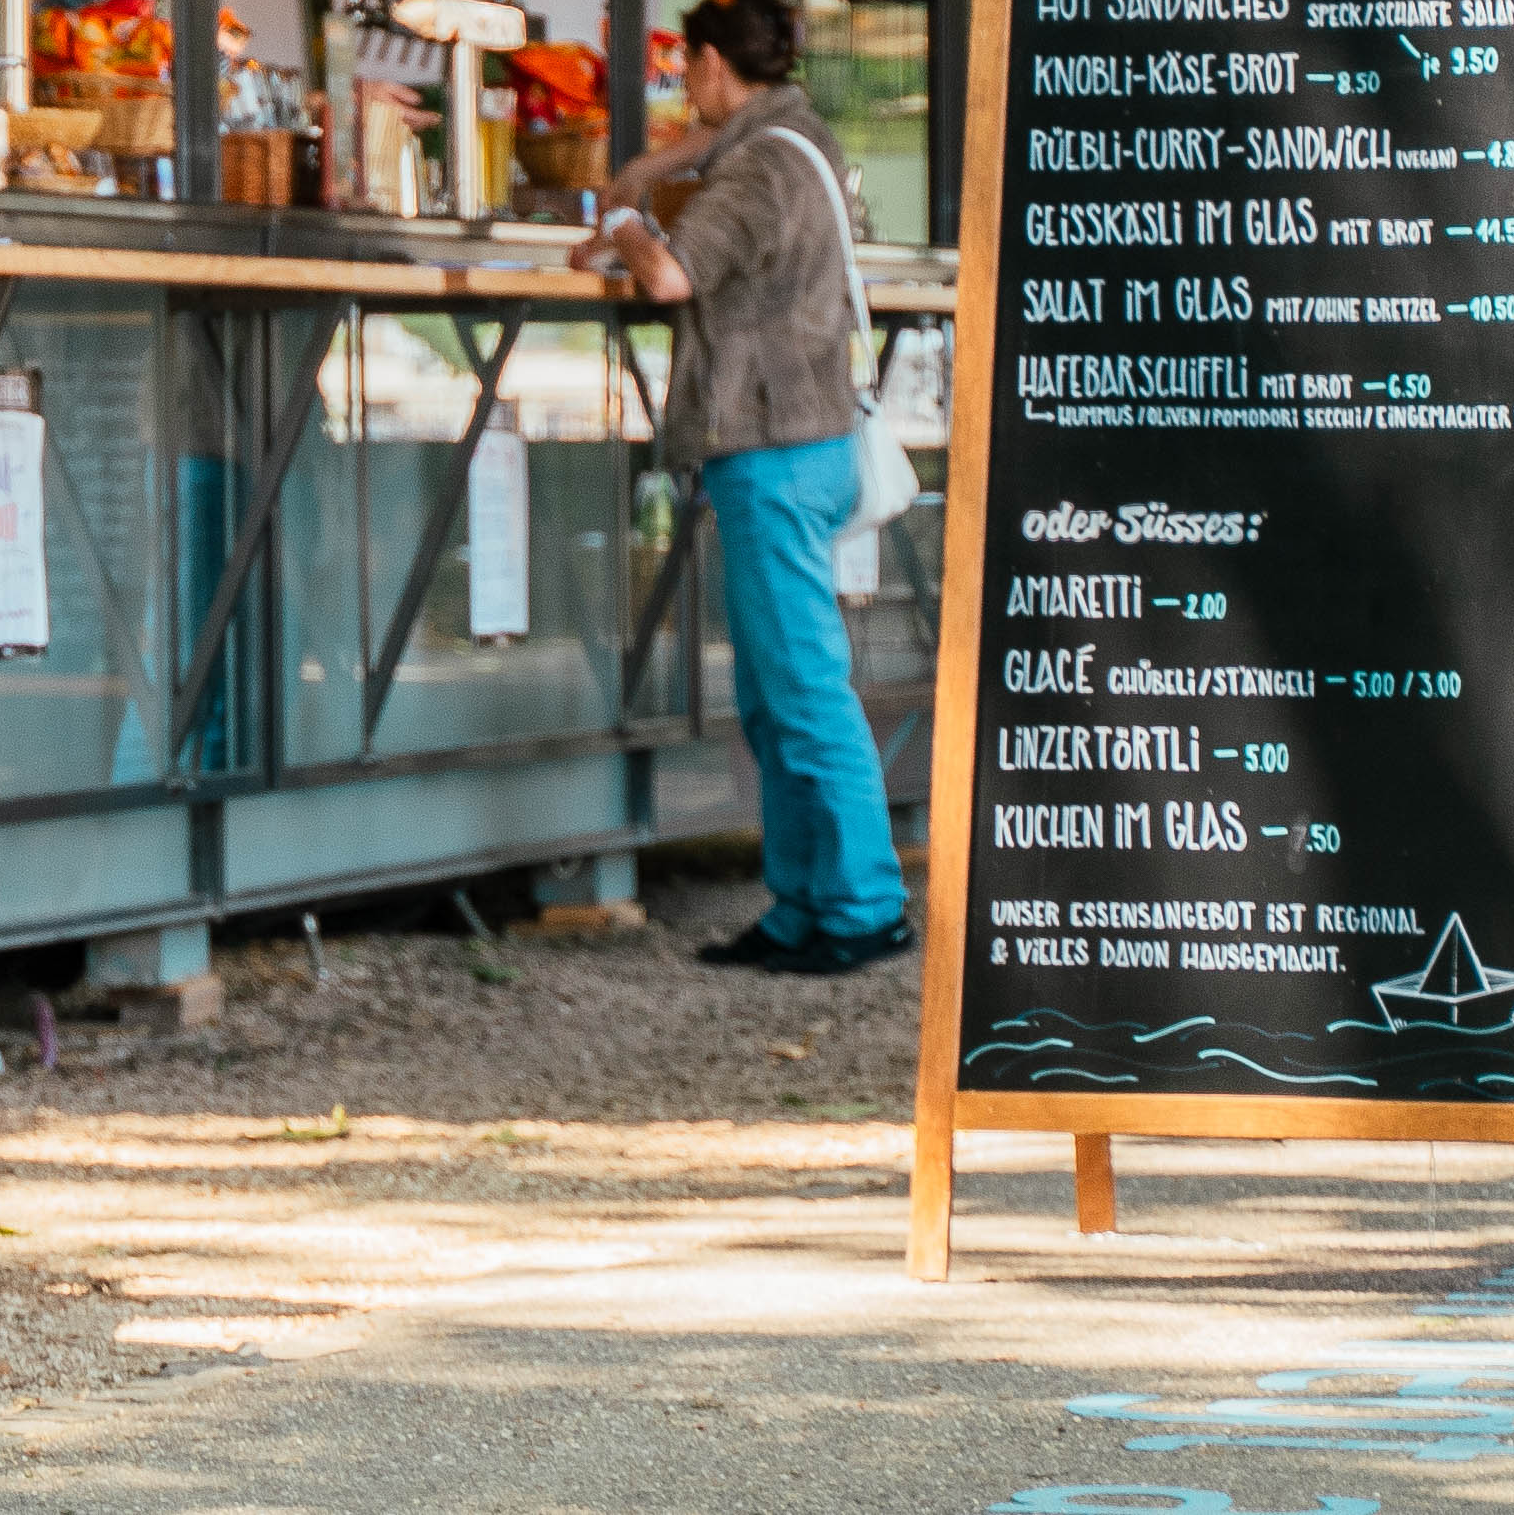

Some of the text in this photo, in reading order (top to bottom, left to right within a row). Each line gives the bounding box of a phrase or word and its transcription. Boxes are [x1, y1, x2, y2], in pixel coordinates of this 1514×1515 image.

[1450, 46, 1498, 76] 9.50
[1245, 198, 1317, 244] GLAS
[1380, 219, 1433, 244] BROT
[1023, 278, 1105, 323] SALAT
[1176, 276, 1252, 322] GLAS
[1365, 297, 1440, 322] BRETZEL
[1302, 374, 1352, 399] BROT
[1388, 374, 1431, 398] 6.50
[1022, 501, 1263, 545] oder Süsses:
[1184, 592, 1226, 620] 2.00
[1004, 644, 1095, 695] GLACÉ
[1245, 742, 1289, 772] 5.00
[995, 802, 1103, 849] KUCHEN
[1165, 800, 1247, 850] GLAS
[992, 900, 1060, 927] UNSER
[1069, 900, 1255, 931] ESSENSANGEBOT
[1100, 939, 1169, 969] DAVON
